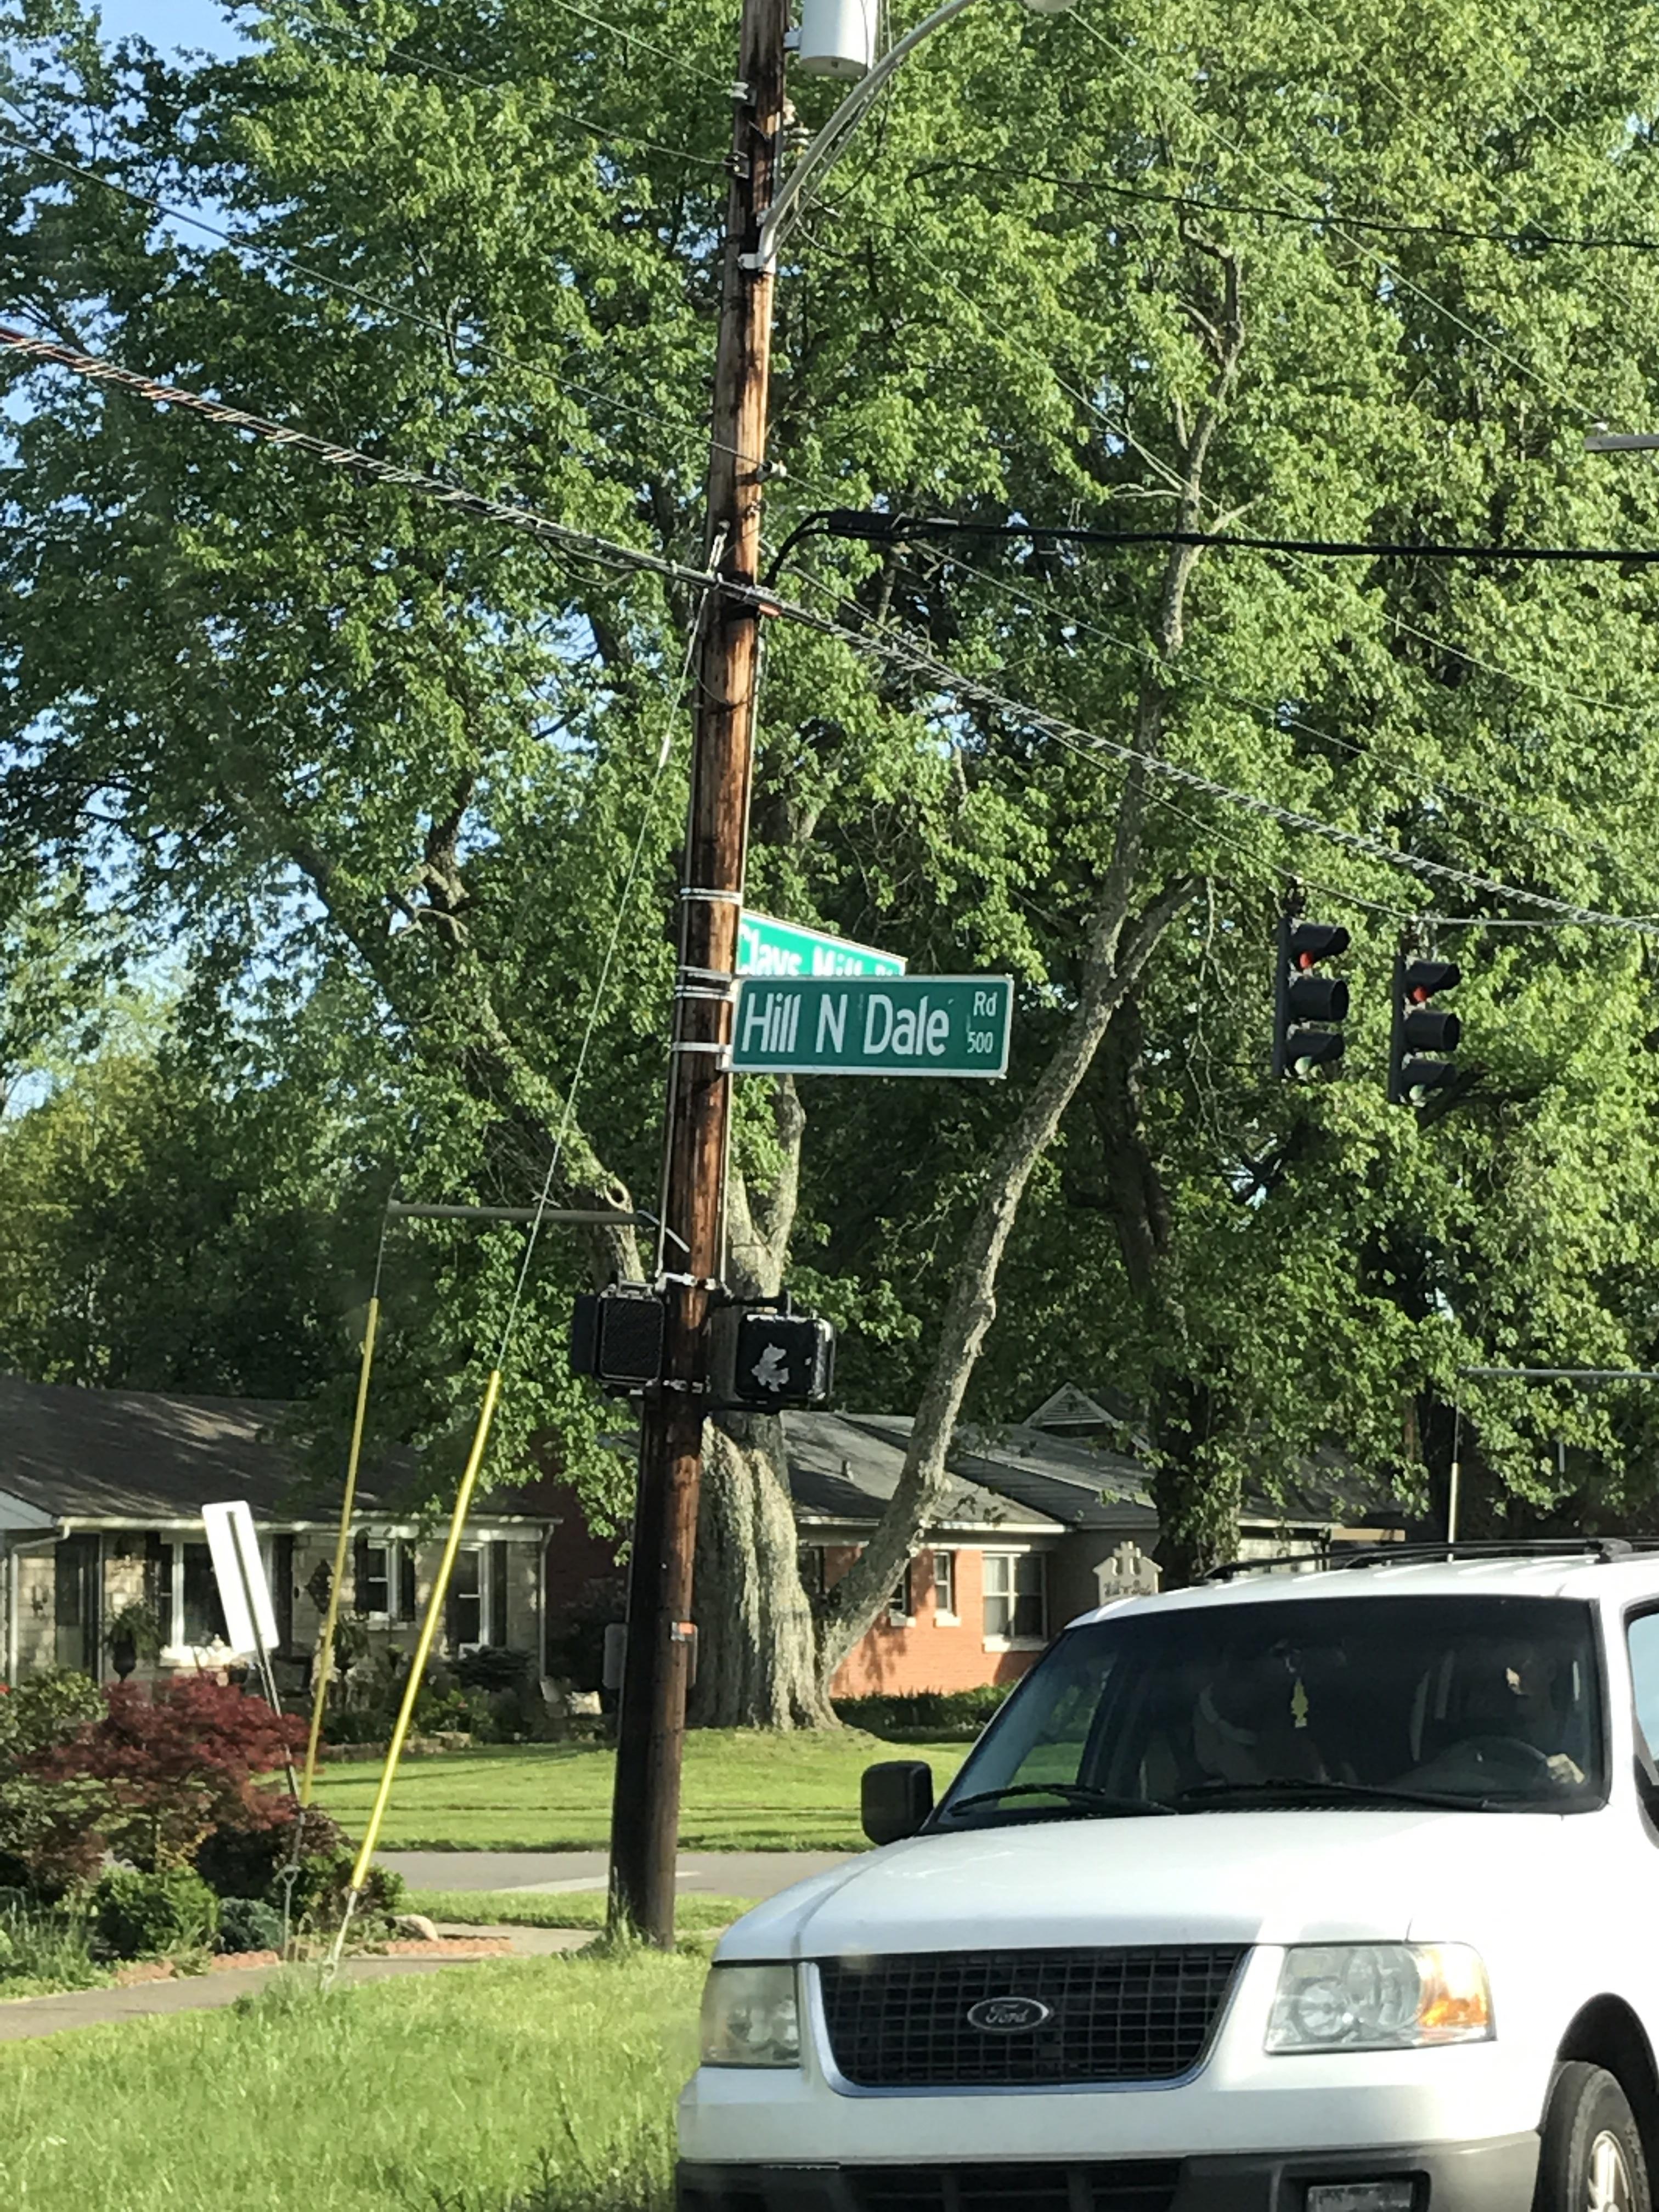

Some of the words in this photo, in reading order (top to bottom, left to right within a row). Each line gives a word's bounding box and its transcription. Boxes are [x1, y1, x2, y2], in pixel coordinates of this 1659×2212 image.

[741, 993, 801, 1052] Hill
[815, 994, 848, 1053] N
[863, 994, 950, 1056] Dale
[973, 991, 997, 1017] Rd
[967, 1031, 993, 1053] 500
[986, 2004, 1029, 2023] Ford
